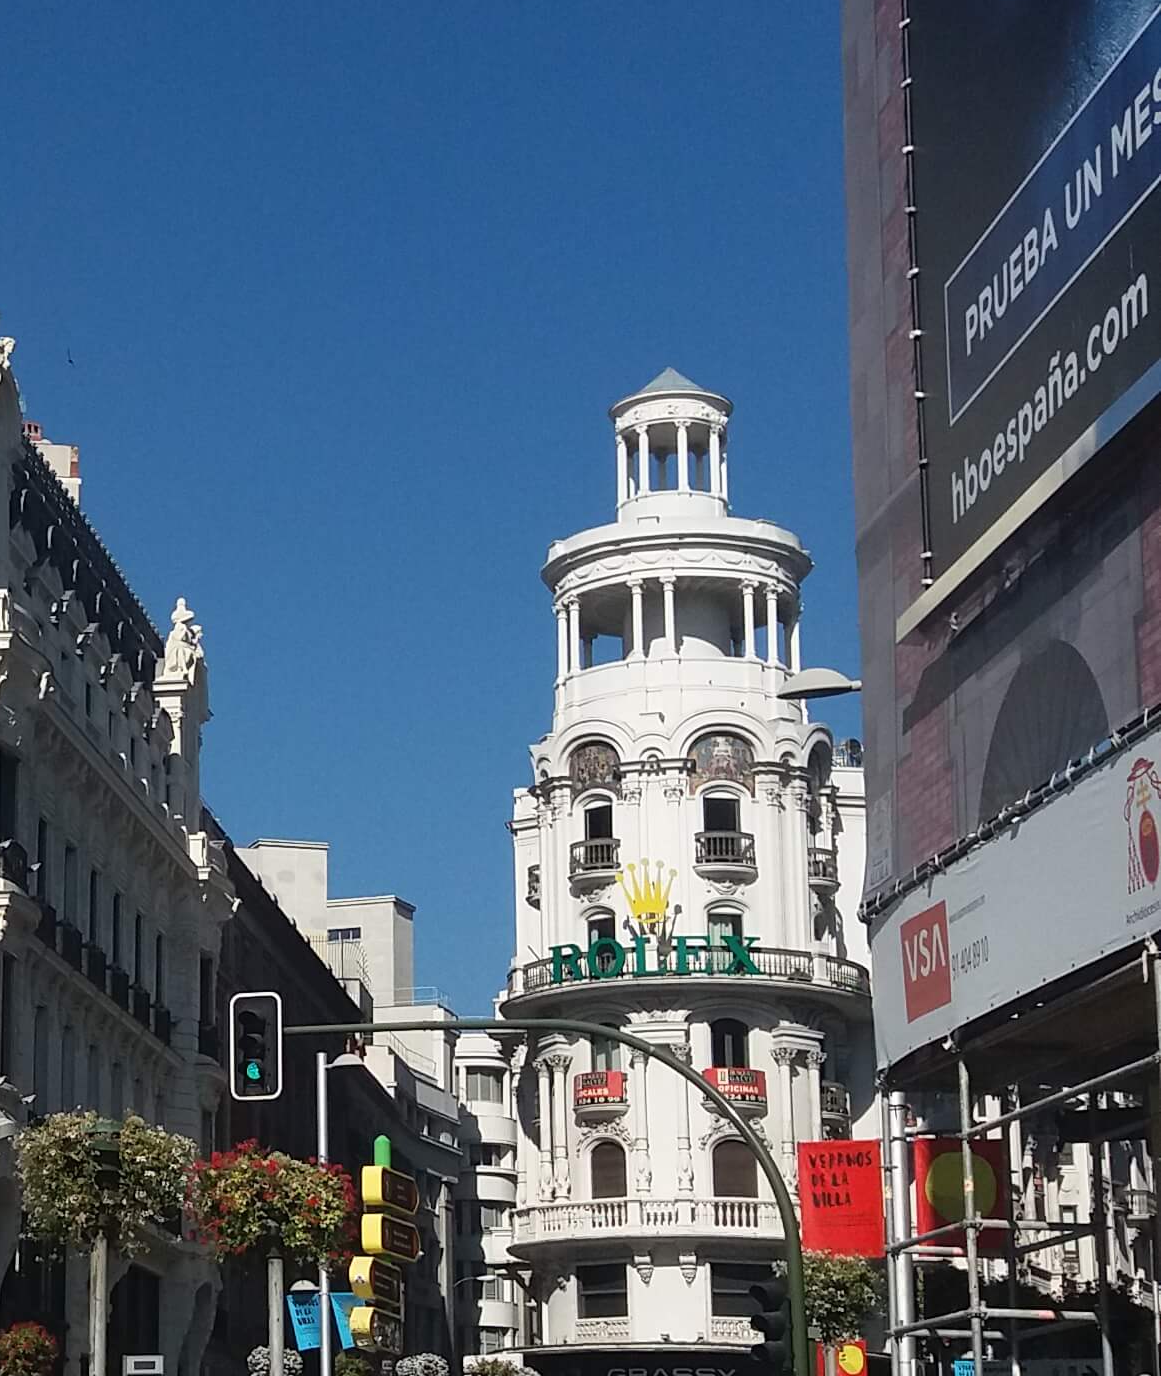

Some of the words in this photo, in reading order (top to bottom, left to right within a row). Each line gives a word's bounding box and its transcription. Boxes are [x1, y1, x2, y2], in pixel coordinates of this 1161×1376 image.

[965, 206, 1058, 357] PRUEBA
[1063, 144, 1103, 230] UN
[951, 272, 1150, 524] hboespaña.com
[548, 936, 761, 984] ROLEX
[717, 1085, 759, 1095] OFICINAS
[808, 1150, 872, 1169] VERANOS
[831, 1172, 849, 1187] LA
